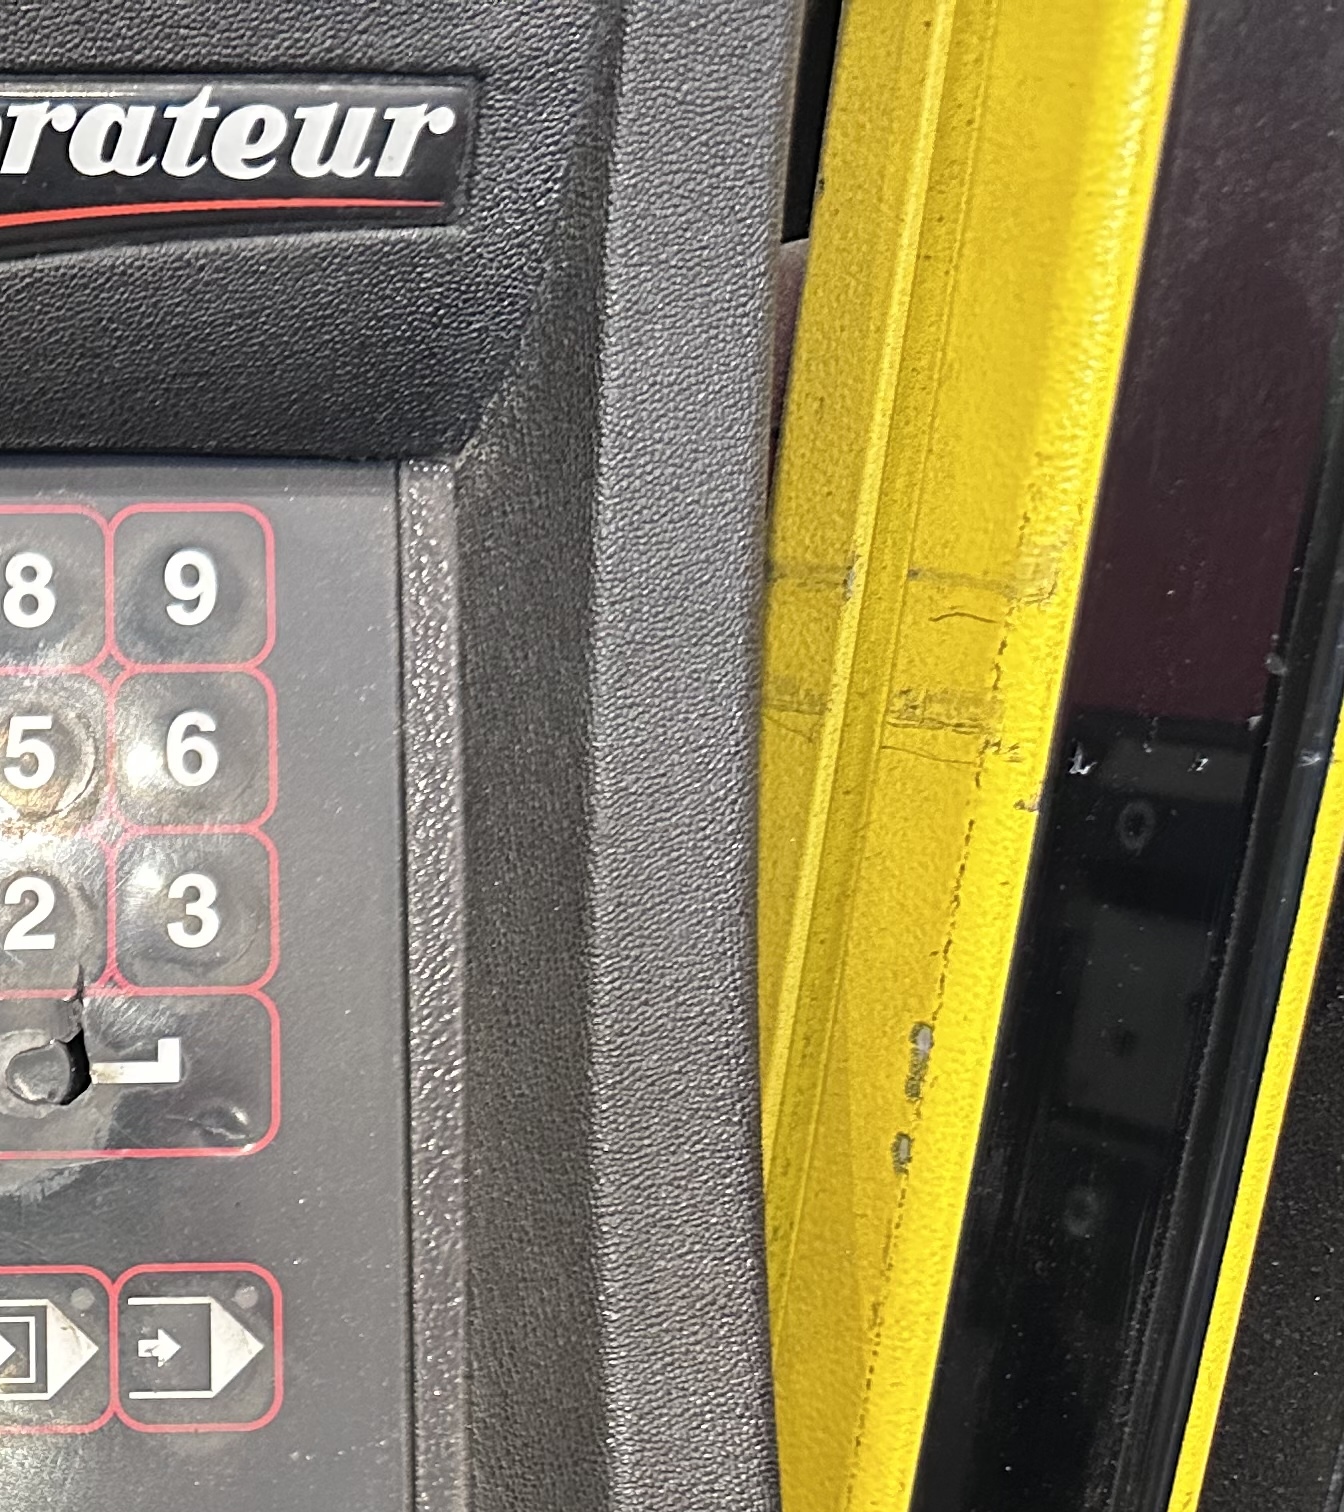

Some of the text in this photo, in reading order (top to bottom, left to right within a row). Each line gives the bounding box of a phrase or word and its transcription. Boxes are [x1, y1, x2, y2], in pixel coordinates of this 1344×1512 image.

[2, 551, 56, 628] 8
[163, 549, 218, 626] 9
[2, 715, 55, 790] 5
[166, 711, 219, 787] 6
[2, 876, 56, 951] 2
[166, 873, 219, 948] 3
